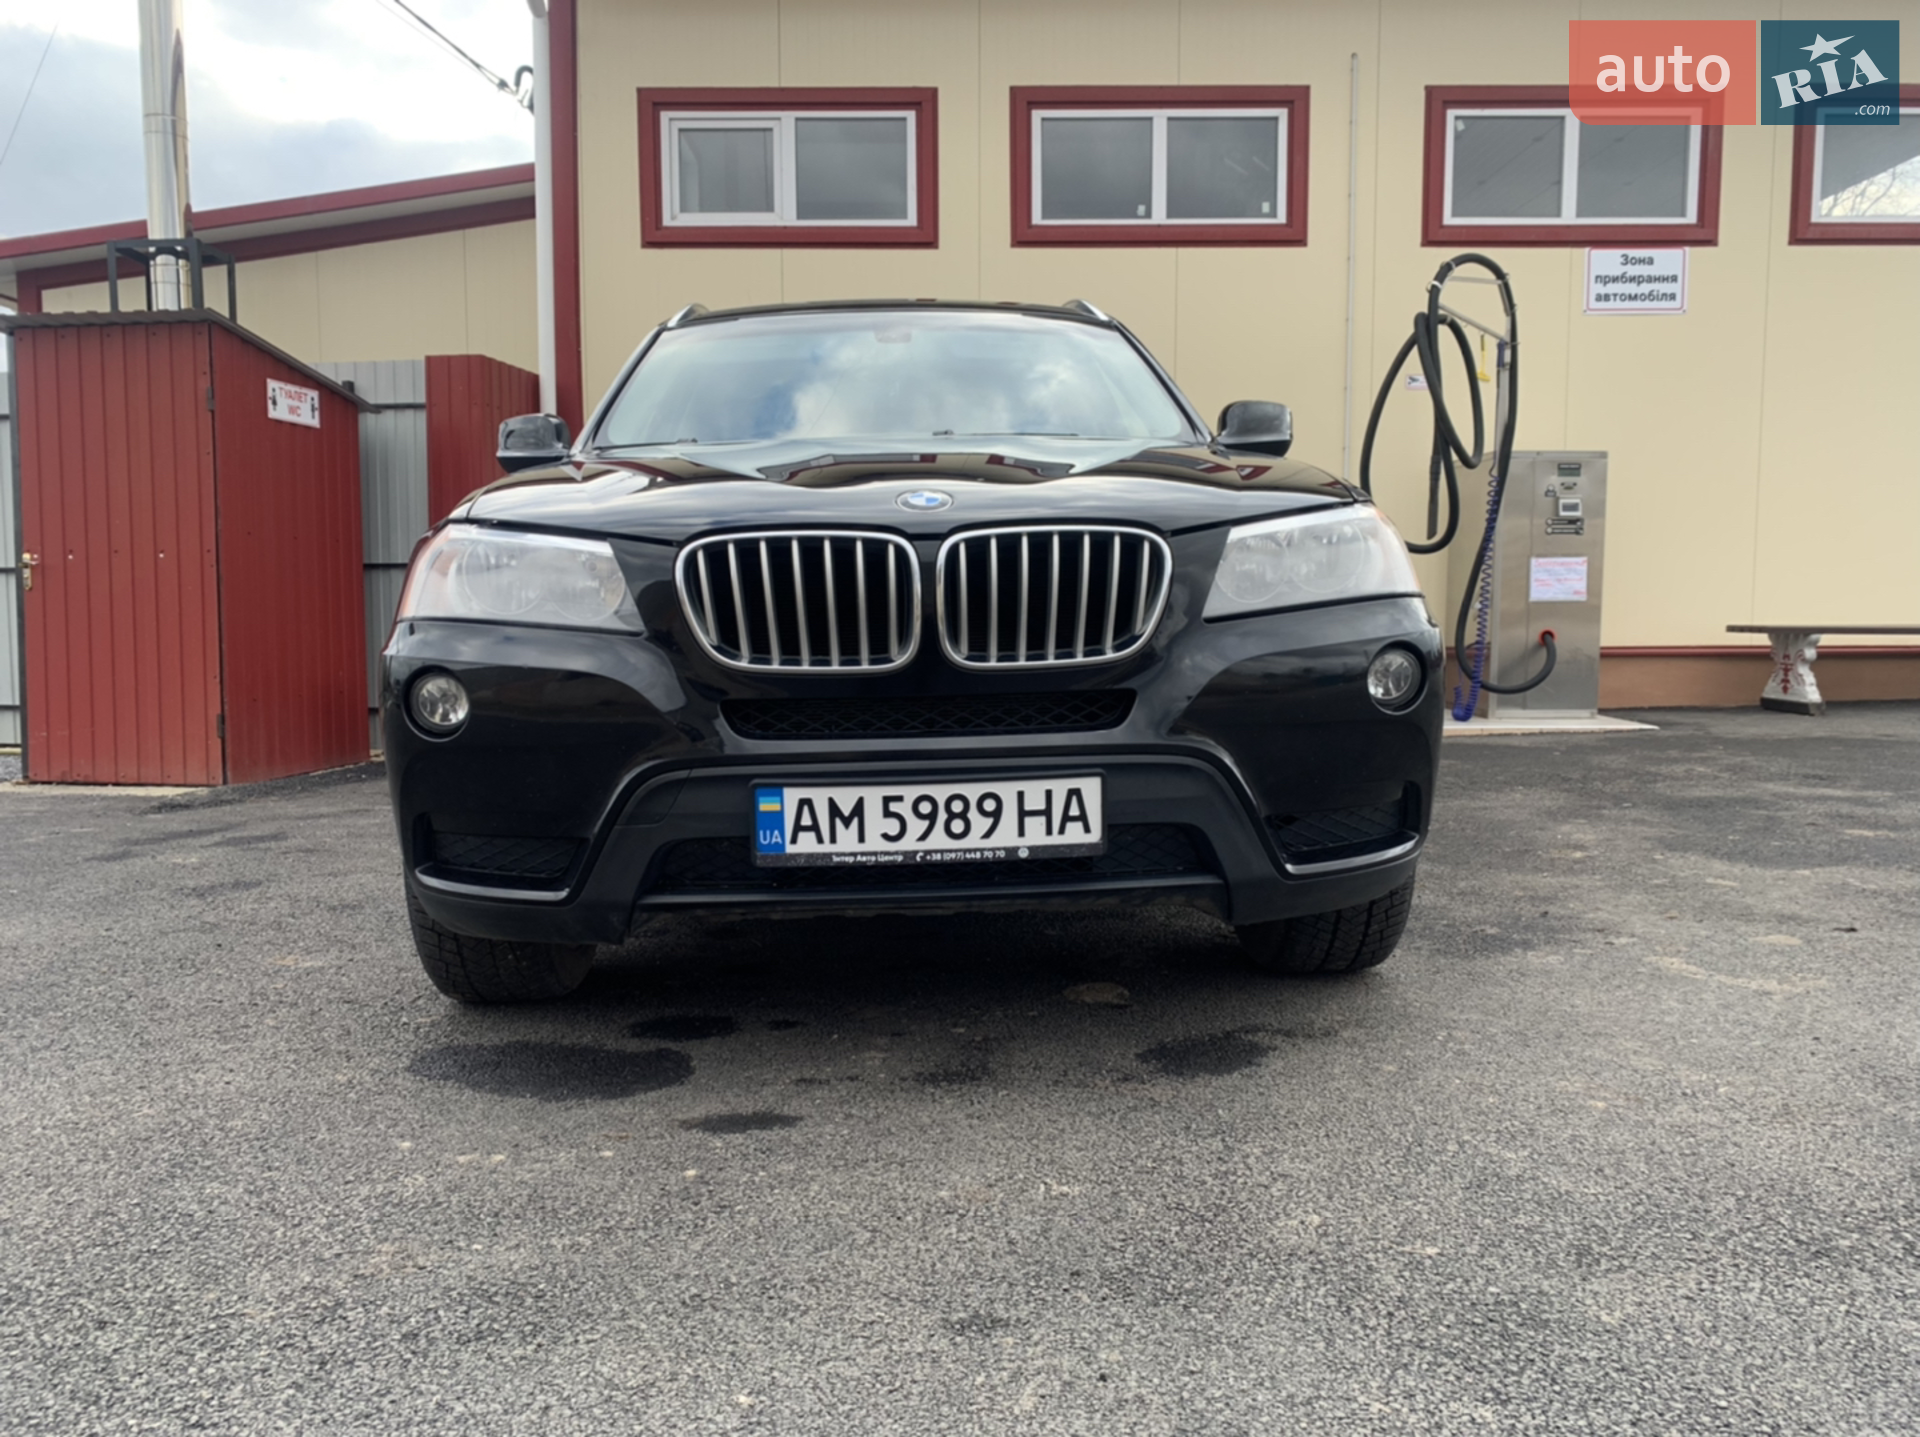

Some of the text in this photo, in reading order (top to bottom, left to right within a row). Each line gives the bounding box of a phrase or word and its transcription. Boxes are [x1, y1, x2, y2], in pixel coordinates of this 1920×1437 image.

[1620, 253, 1655, 266] Зона
[1594, 271, 1678, 287] прибирання
[1594, 289, 1677, 302] автомобіля
[278, 386, 308, 404] ТУАЛЕТ
[287, 404, 301, 417] WC
[789, 787, 1092, 845] AM 5989 HA
[759, 829, 783, 844] UA
